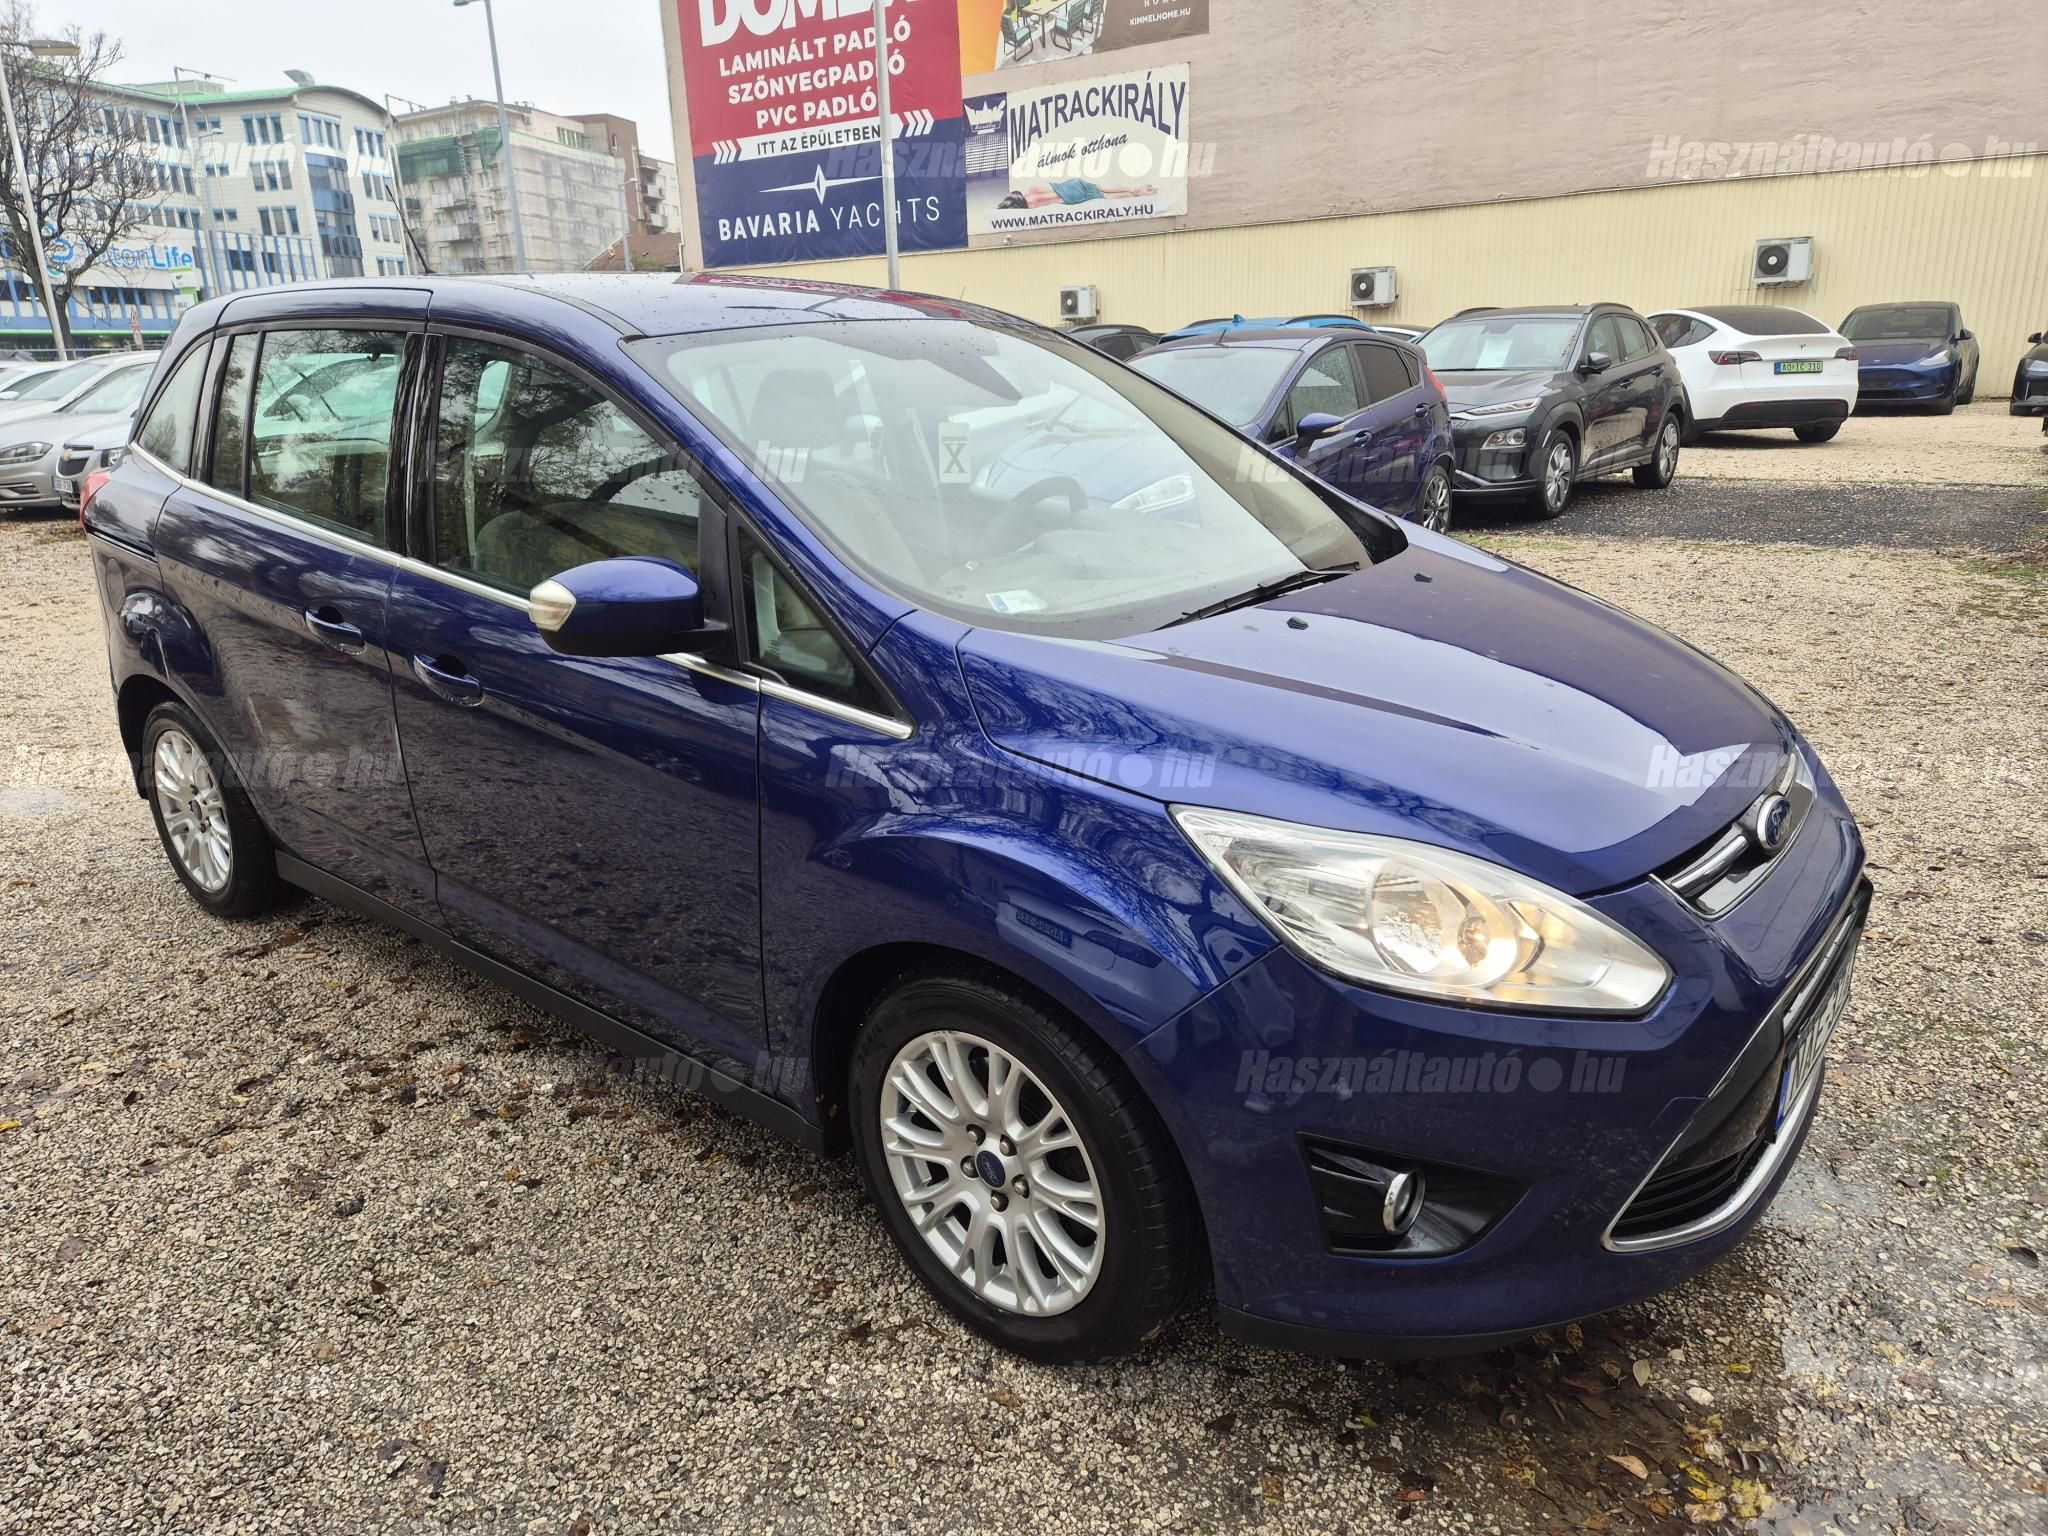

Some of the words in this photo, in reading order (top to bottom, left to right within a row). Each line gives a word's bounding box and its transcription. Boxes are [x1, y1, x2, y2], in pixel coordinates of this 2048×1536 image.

[1129, 8, 1191, 26] KIMMELHOME.HU
[719, 37, 827, 77] LAMINÁLT
[728, 49, 905, 104] SZŐNYEGPADÓ
[756, 104, 797, 129] PVC
[803, 86, 878, 121] PADLÓ
[1010, 71, 1186, 165] MATRACKIRÁLY
[757, 141, 776, 155] ITT
[780, 137, 798, 151] AZ
[801, 124, 881, 150] ÉPÜLETBEN
[1038, 143, 1077, 168] álmok
[1081, 133, 1128, 157] otthona
[718, 209, 820, 241] BAVARIA
[991, 204, 1154, 230] WWW.MATRACKIRALY.HU
